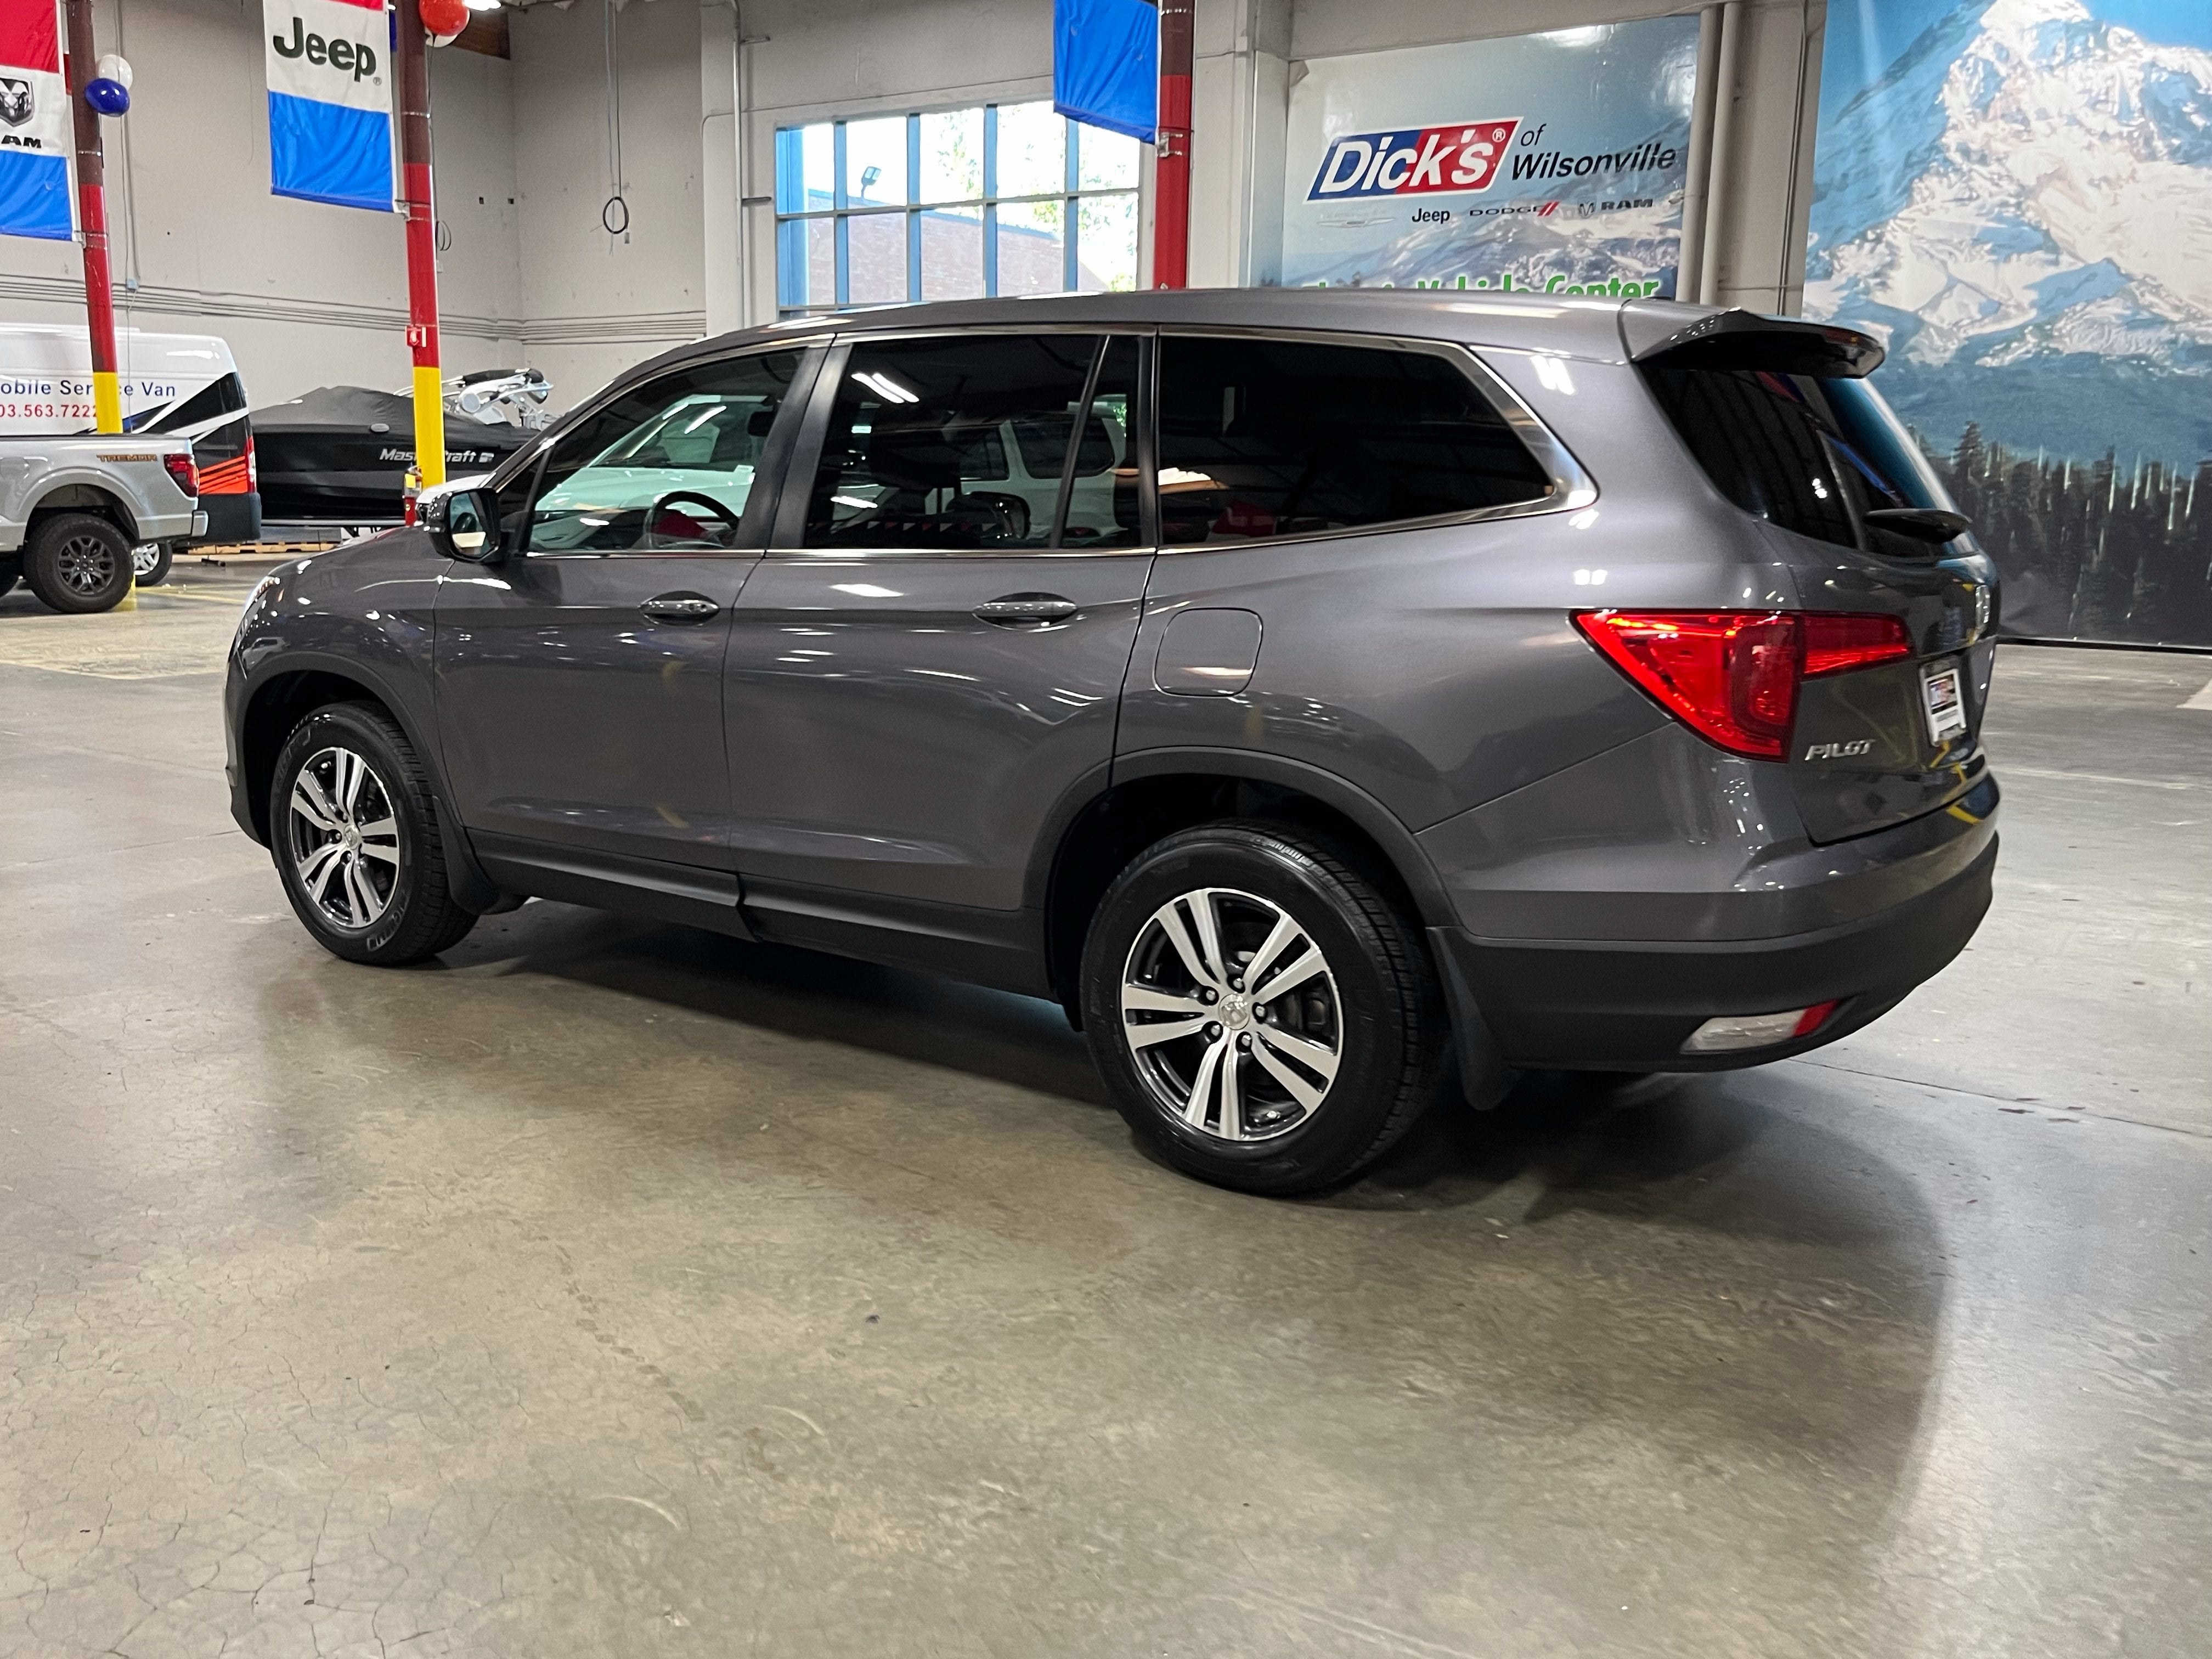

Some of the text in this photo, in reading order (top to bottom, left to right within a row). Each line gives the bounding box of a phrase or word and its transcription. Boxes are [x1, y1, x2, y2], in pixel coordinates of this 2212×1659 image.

[273, 16, 377, 83] Jeep
[1318, 123, 1547, 194] Dick's of
[1511, 143, 1677, 181] Wilsonville
[1601, 198, 1654, 211] RAM
[1412, 208, 1451, 224] Jeep
[60, 380, 134, 397] Sere
[142, 381, 176, 397] Van
[96, 454, 158, 462] TREMOR
[1804, 738, 1876, 761] PILOT
